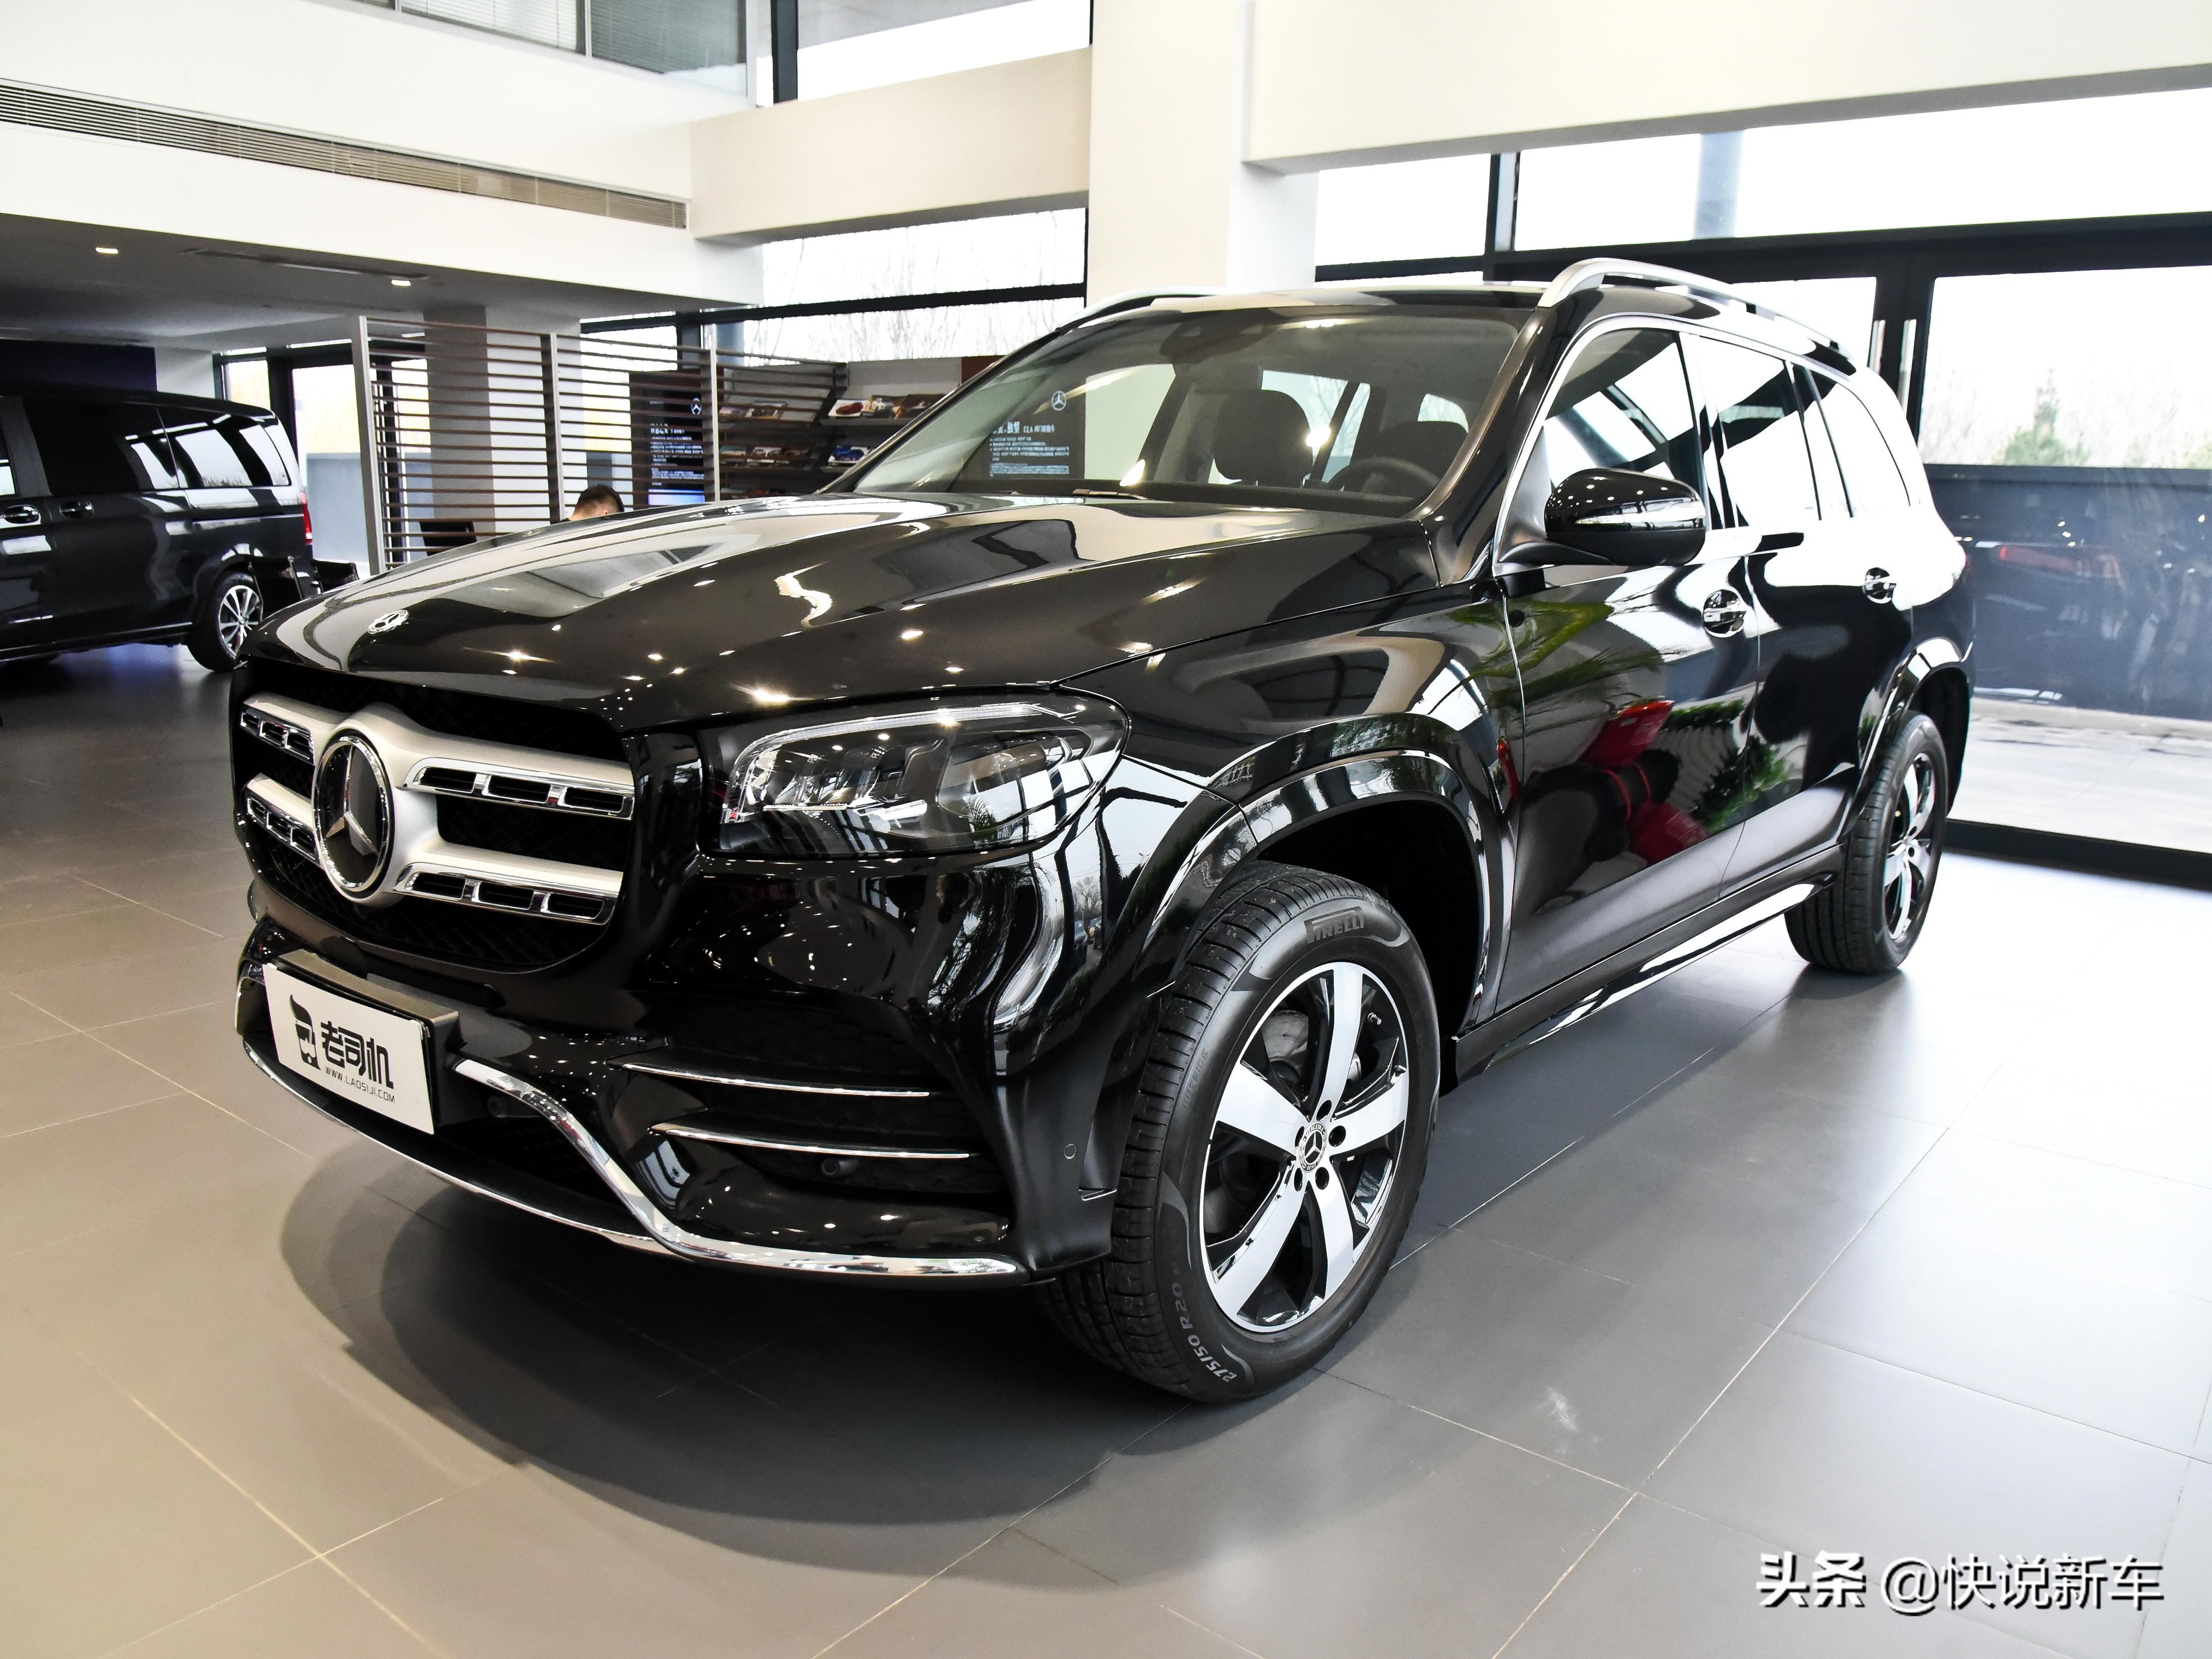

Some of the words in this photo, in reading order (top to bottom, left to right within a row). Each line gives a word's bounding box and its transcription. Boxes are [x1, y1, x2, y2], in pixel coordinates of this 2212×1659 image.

[1304, 906, 1364, 944] PIRELLI
[321, 1021, 394, 1089] 老司机
[326, 1067, 395, 1103] WWW.LAOSIJI.COM
[1306, 1124, 1324, 1137] MERCEDES
[1172, 1282, 1193, 1329] R20
[1188, 1334, 1238, 1382] 275/50
